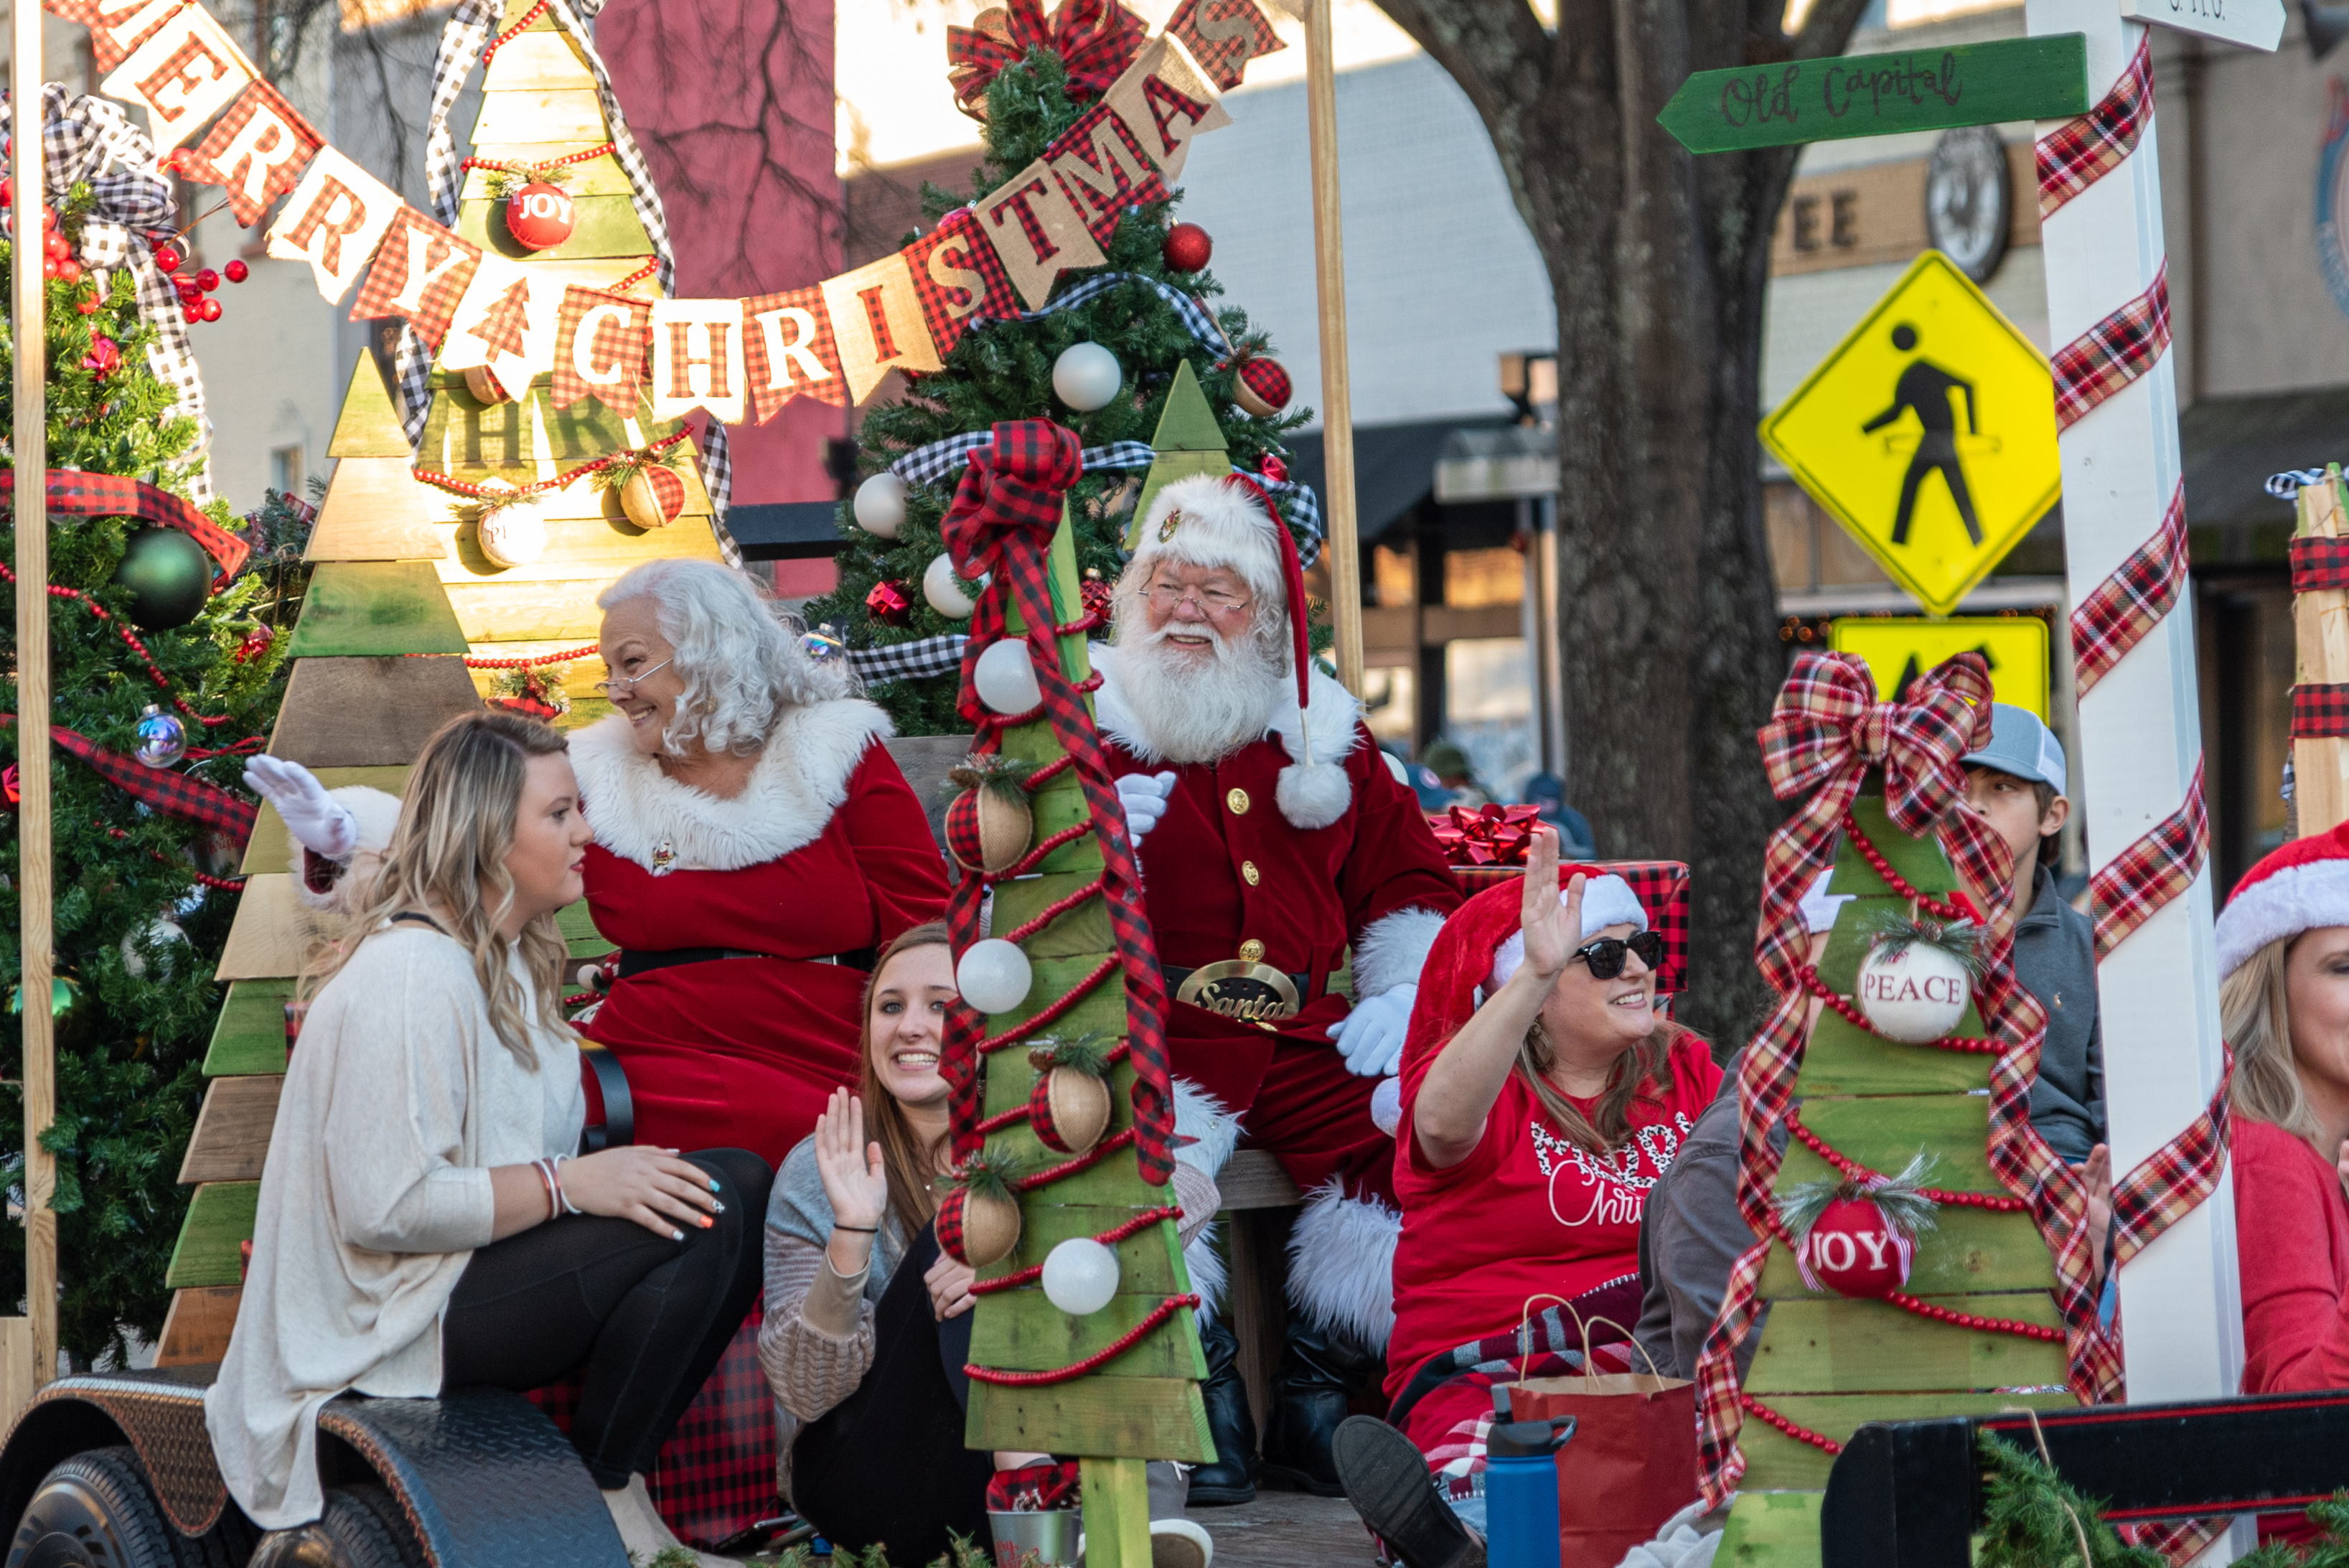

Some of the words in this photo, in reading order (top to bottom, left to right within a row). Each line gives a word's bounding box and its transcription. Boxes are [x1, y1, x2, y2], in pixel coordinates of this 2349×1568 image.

[1722, 65, 1800, 128] Old
[1824, 51, 1963, 118] Capital
[519, 192, 573, 225] JOY
[572, 0, 1256, 398] CHRISTMAS
[1194, 982, 1286, 1020] Santa
[1864, 972, 1961, 1005] PEACE
[1811, 1230, 1888, 1272] JOY
